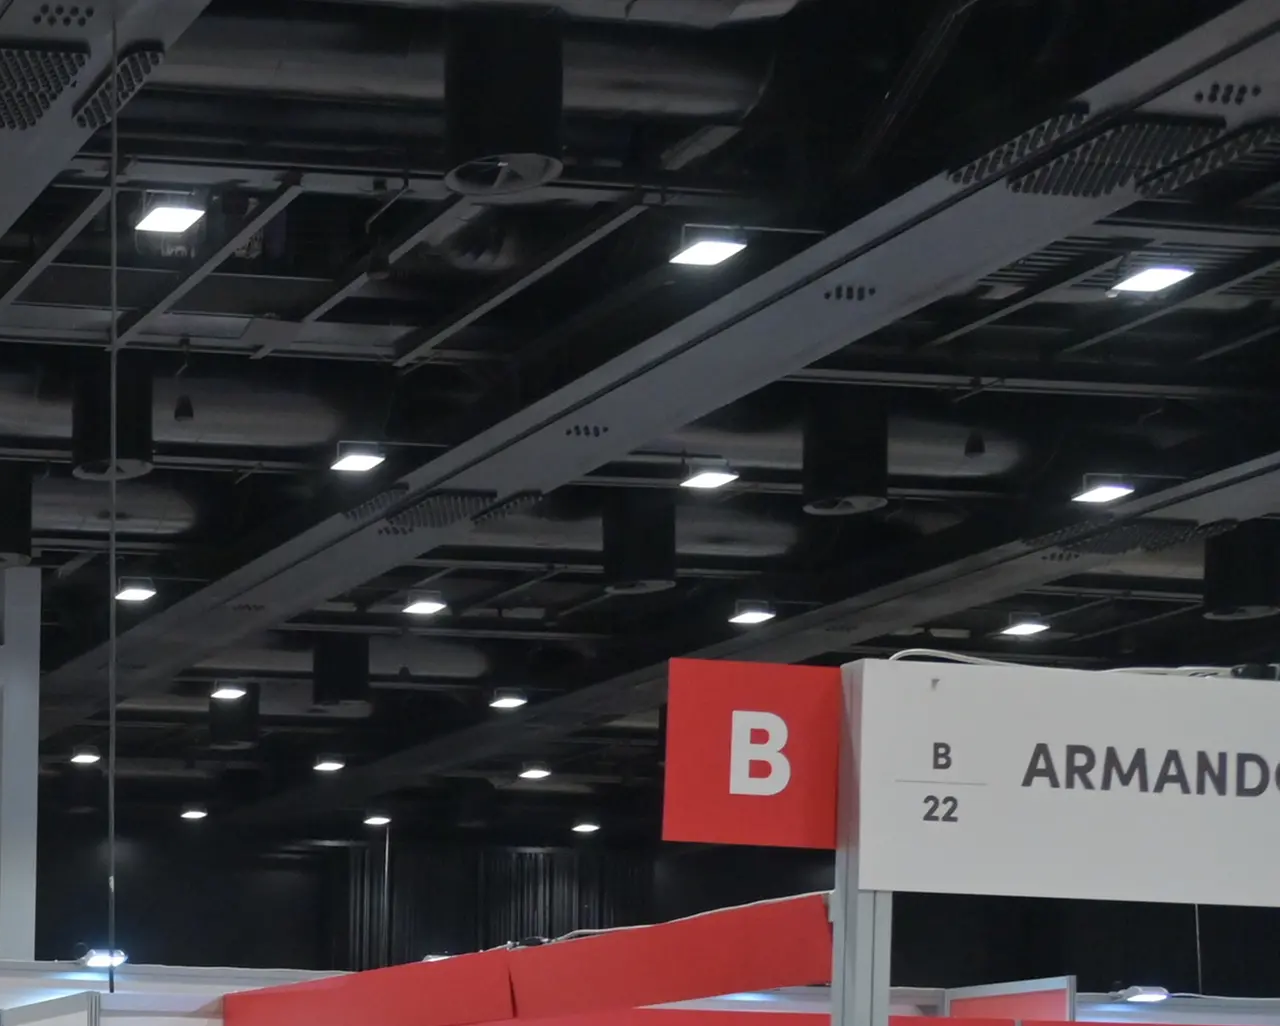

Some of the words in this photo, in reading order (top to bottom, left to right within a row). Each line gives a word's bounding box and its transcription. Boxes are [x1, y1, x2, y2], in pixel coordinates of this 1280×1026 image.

[729, 710, 791, 796] B
[932, 742, 952, 770] B
[1021, 743, 1280, 798] ARMAND
[923, 795, 959, 822] 22
